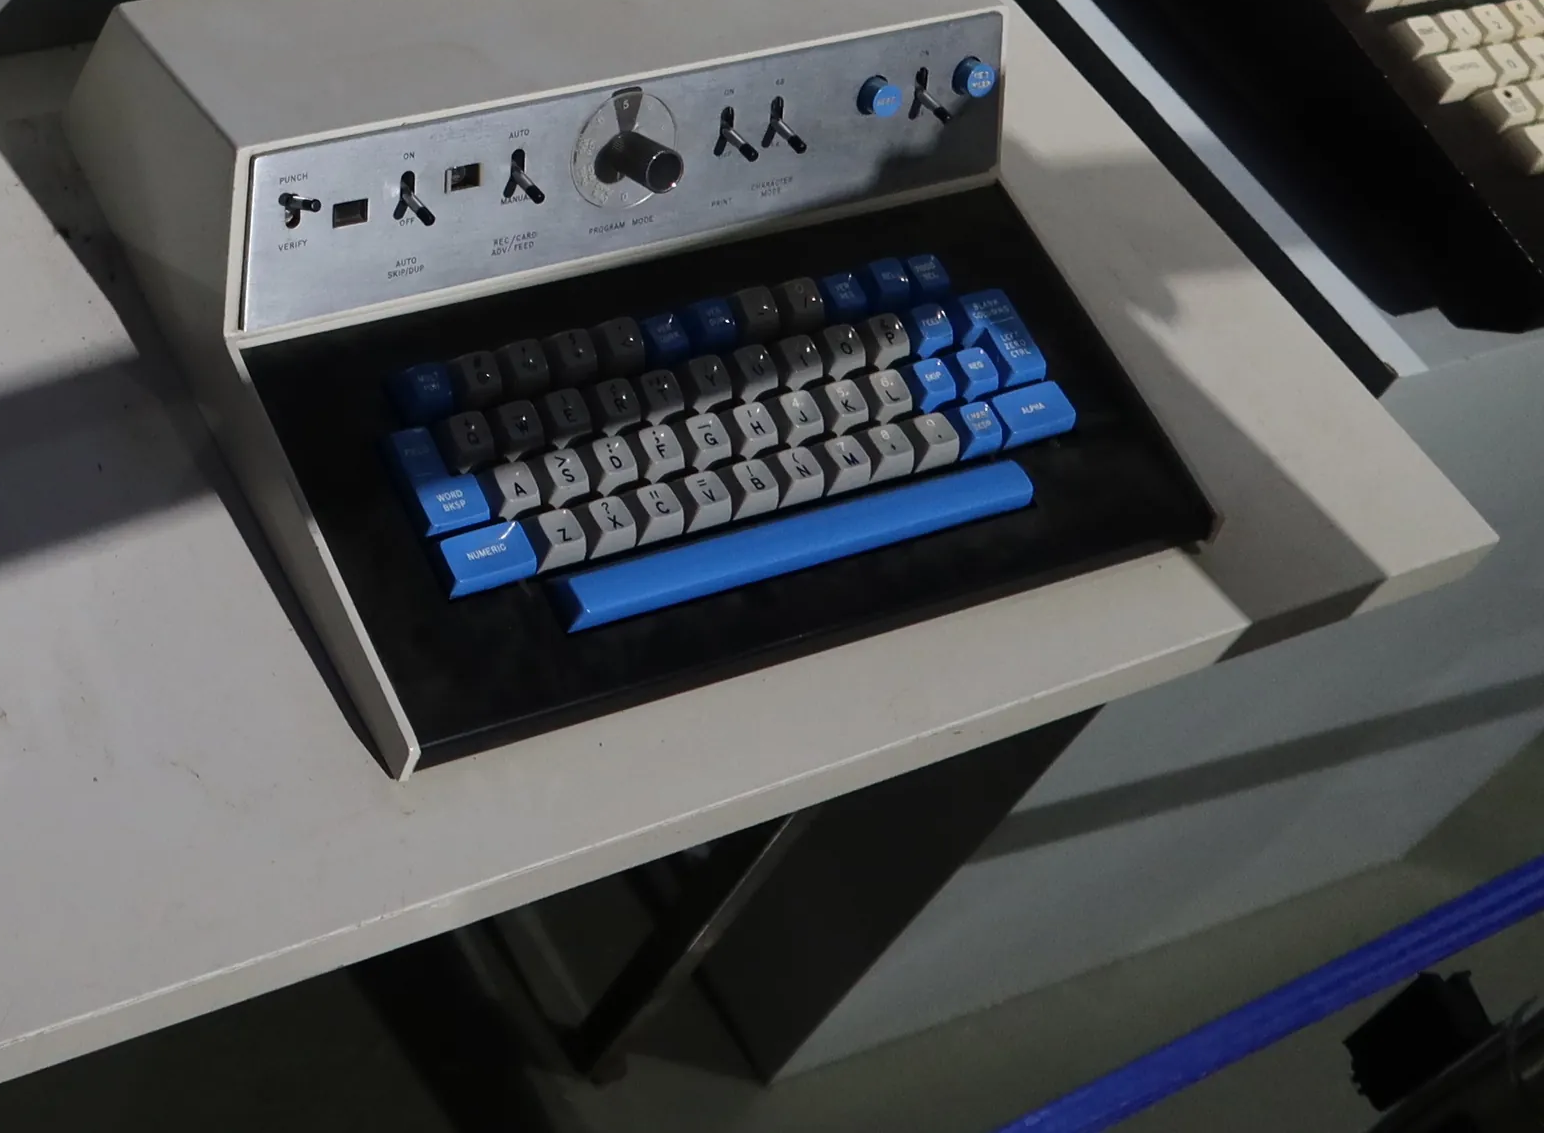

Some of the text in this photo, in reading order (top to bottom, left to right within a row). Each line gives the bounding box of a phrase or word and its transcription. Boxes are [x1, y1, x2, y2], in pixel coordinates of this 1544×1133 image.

[508, 129, 530, 140] AUTO
[403, 152, 415, 160] ON
[279, 173, 308, 185] PUNCH
[750, 176, 794, 191] CHARACTER
[500, 193, 530, 205] MANUA
[711, 197, 733, 207] PRINT
[399, 217, 415, 227] OFF
[588, 215, 654, 235] PROGRAM MODE
[278, 239, 308, 252] VERIFY
[395, 257, 417, 268] AUTO
[387, 264, 425, 279] SKIP/DUP
[885, 331, 895, 345] P
[1004, 339, 1027, 351] ZERO
[1010, 347, 1032, 358] CTRL
[705, 374, 717, 387] Y
[924, 371, 942, 382] SKIP
[885, 390, 901, 402] L
[613, 398, 628, 413] R
[841, 399, 856, 412] K
[1020, 402, 1046, 415] ALPHA
[563, 407, 578, 424] E
[799, 410, 808, 423] J
[750, 421, 766, 435] H
[704, 432, 719, 446] G
[656, 444, 666, 458] F
[609, 455, 622, 469] D
[842, 452, 860, 466] M
[561, 468, 575, 483] S
[796, 465, 812, 477] N
[513, 482, 527, 496] A
[750, 477, 766, 490] B
[436, 489, 464, 503] WORD
[702, 489, 716, 502] V
[442, 499, 467, 513] BKSP
[656, 501, 670, 514] C
[607, 514, 624, 530] X
[557, 528, 572, 542] Z
[465, 543, 507, 561] NUMERIC
